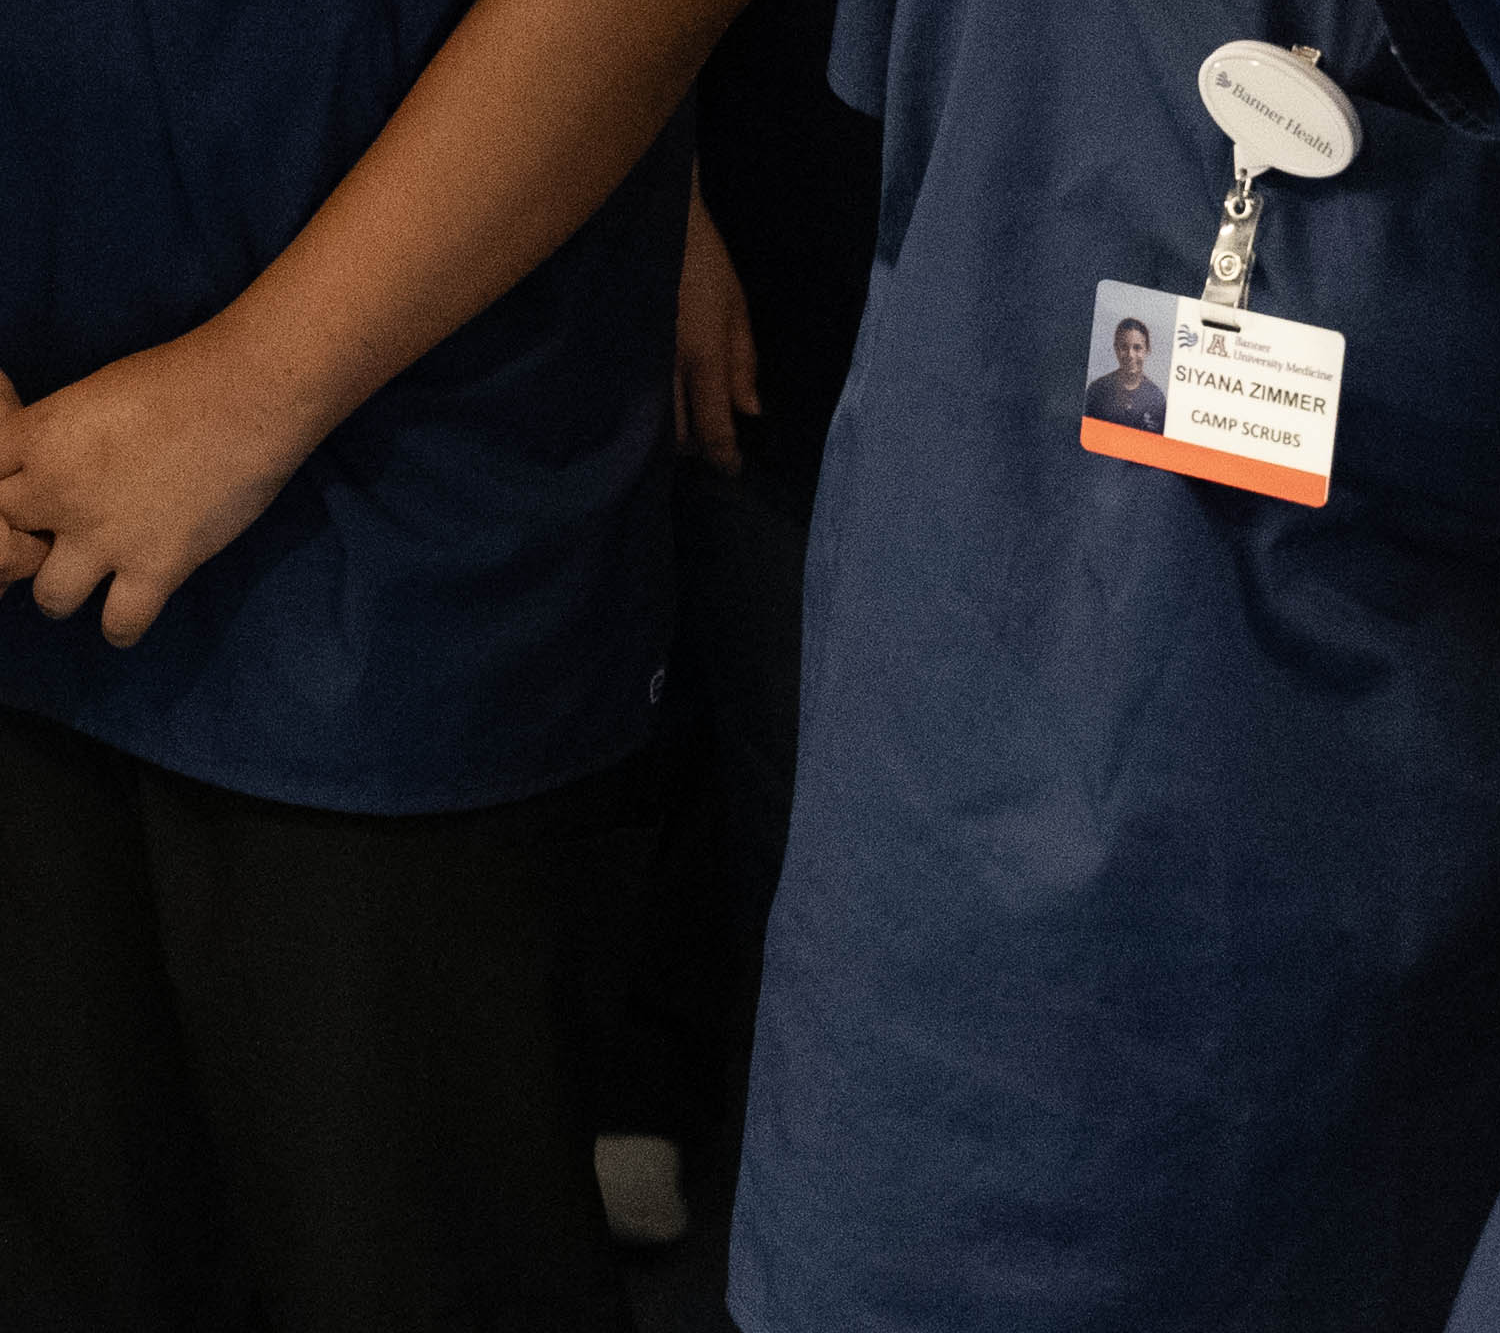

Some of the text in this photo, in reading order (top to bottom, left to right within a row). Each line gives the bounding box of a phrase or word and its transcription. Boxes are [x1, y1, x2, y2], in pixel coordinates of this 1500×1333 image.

[1231, 82, 1334, 158] Banner Health
[1234, 336, 1271, 353] Banner
[1233, 349, 1334, 381] University Medicine
[1175, 365, 1326, 415] SIYANA ZIMMER
[1191, 409, 1302, 448] CAMP SCRUBS
